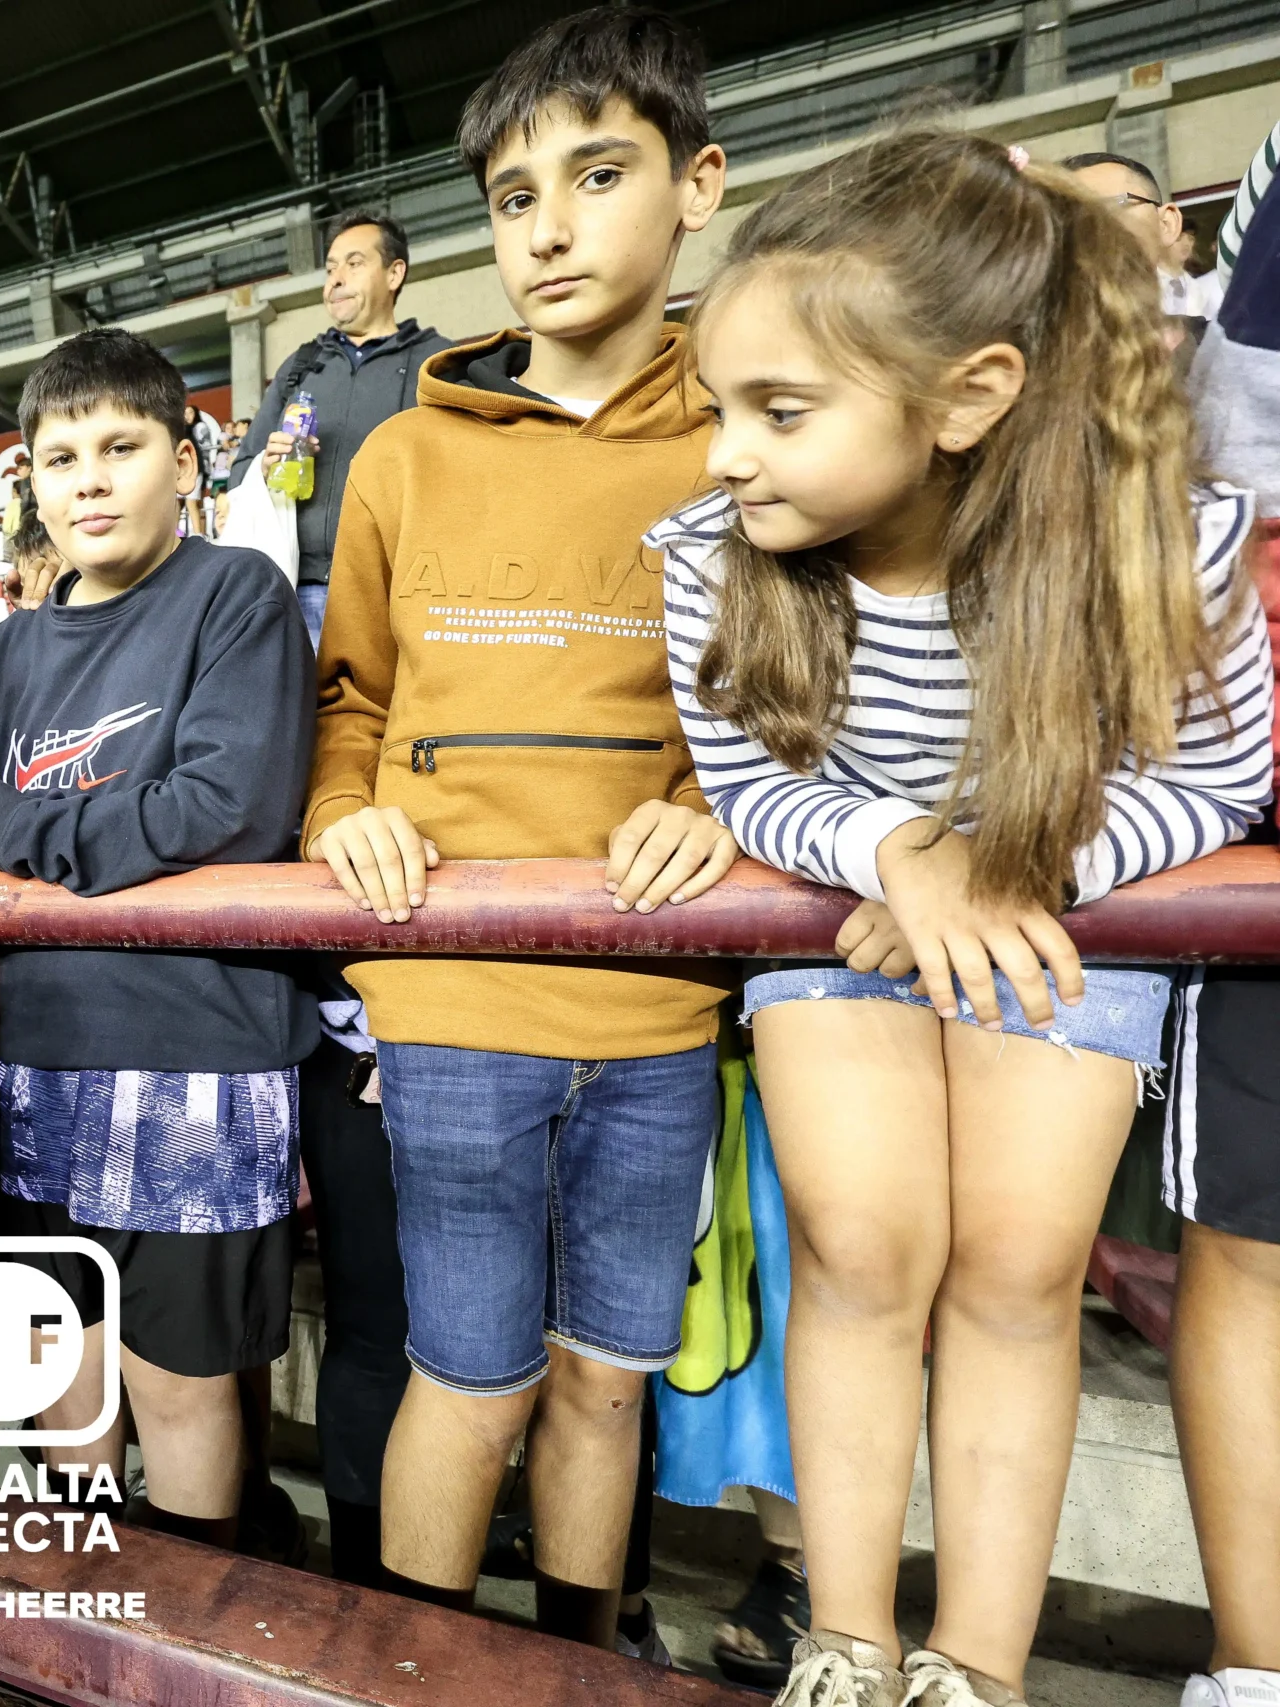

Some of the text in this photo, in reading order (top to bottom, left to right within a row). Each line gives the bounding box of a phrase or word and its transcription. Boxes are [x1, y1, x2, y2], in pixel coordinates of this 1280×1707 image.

[428, 606, 453, 615] THIS
[455, 607, 467, 616] IS
[468, 608, 476, 617] A
[479, 609, 516, 618] GREEN
[518, 609, 577, 619] MESSAGE.
[580, 612, 601, 623] THE
[603, 616, 642, 627] WORLD
[445, 618, 496, 628] RESERVE
[498, 620, 542, 628] WOODS,
[546, 619, 612, 635] MOUNTAINS
[614, 628, 638, 638] AND
[424, 630, 569, 648] GO ONE STEP FURTHER.
